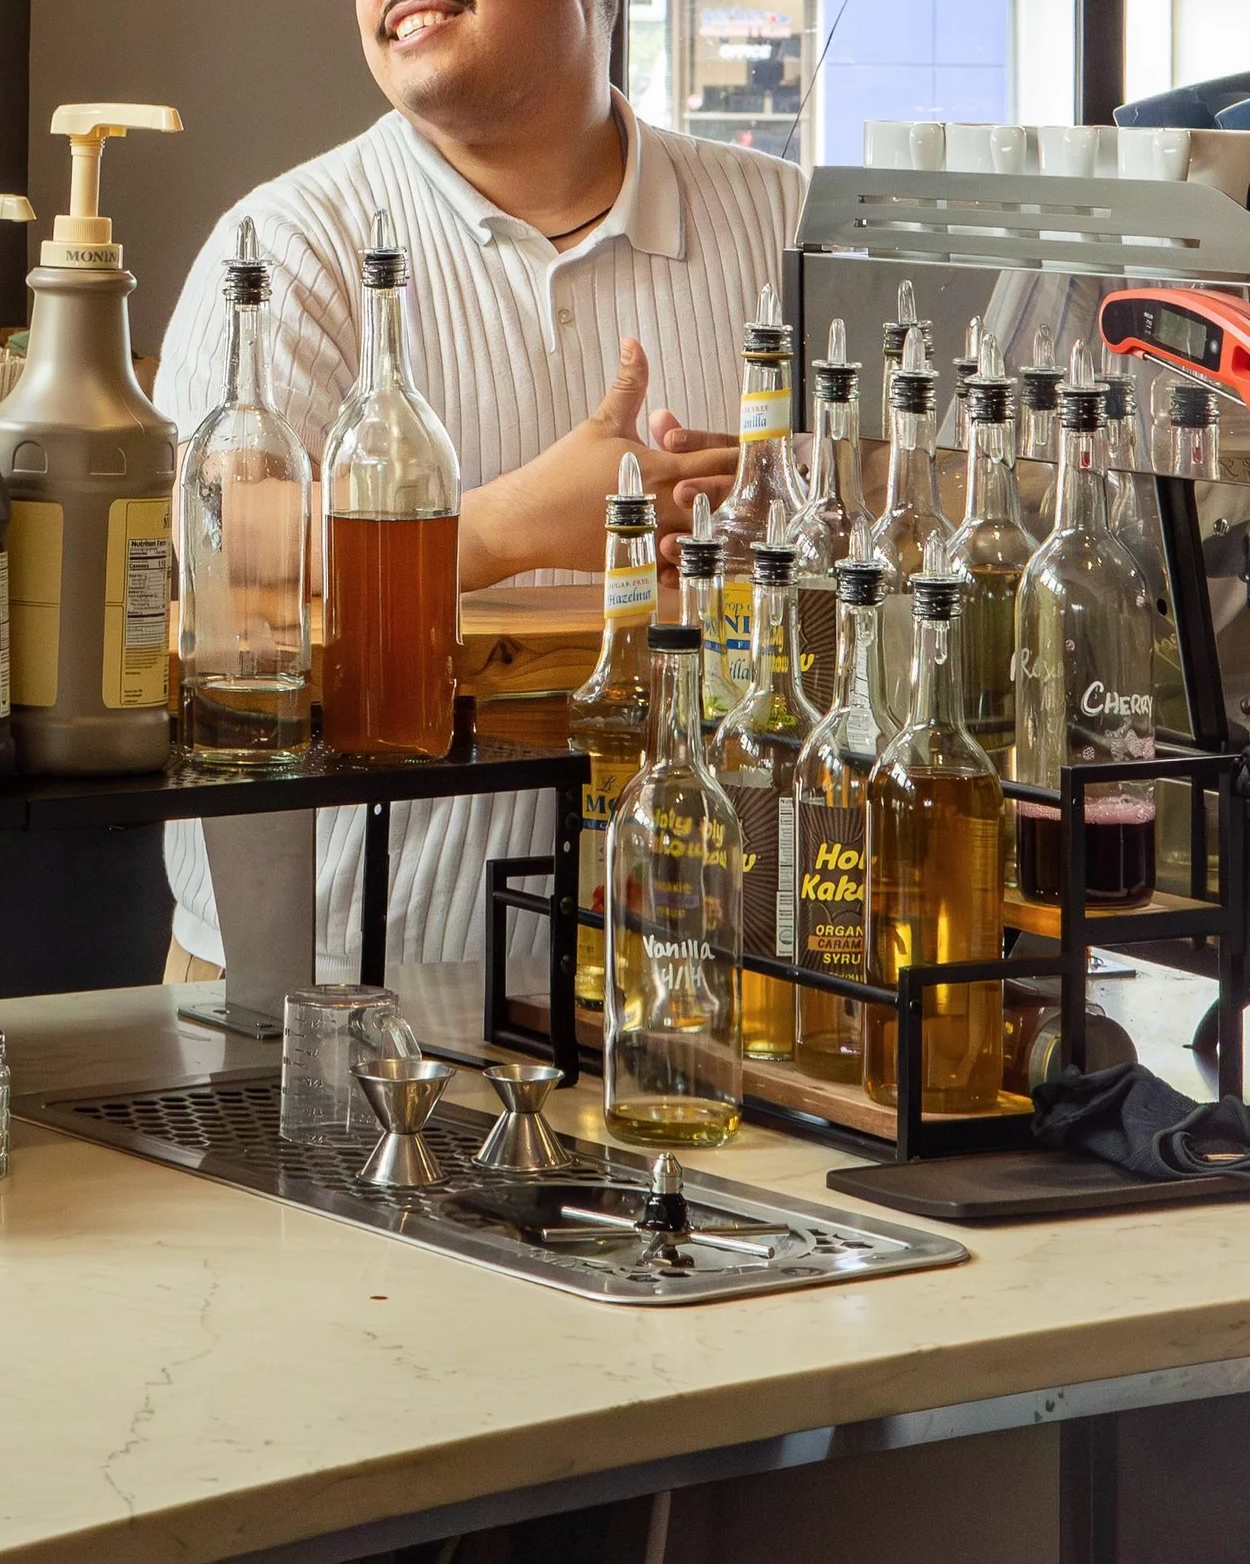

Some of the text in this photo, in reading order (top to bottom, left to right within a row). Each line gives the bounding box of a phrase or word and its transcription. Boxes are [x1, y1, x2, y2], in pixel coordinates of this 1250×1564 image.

[66, 250, 117, 263] MONIN
[1081, 681, 1153, 718] CHERRY
[815, 842, 865, 870] Hol
[816, 924, 863, 936] ORGAN
[643, 934, 716, 960] Vanilla
[817, 938, 862, 949] CARAM
[823, 953, 861, 965] SYRU
